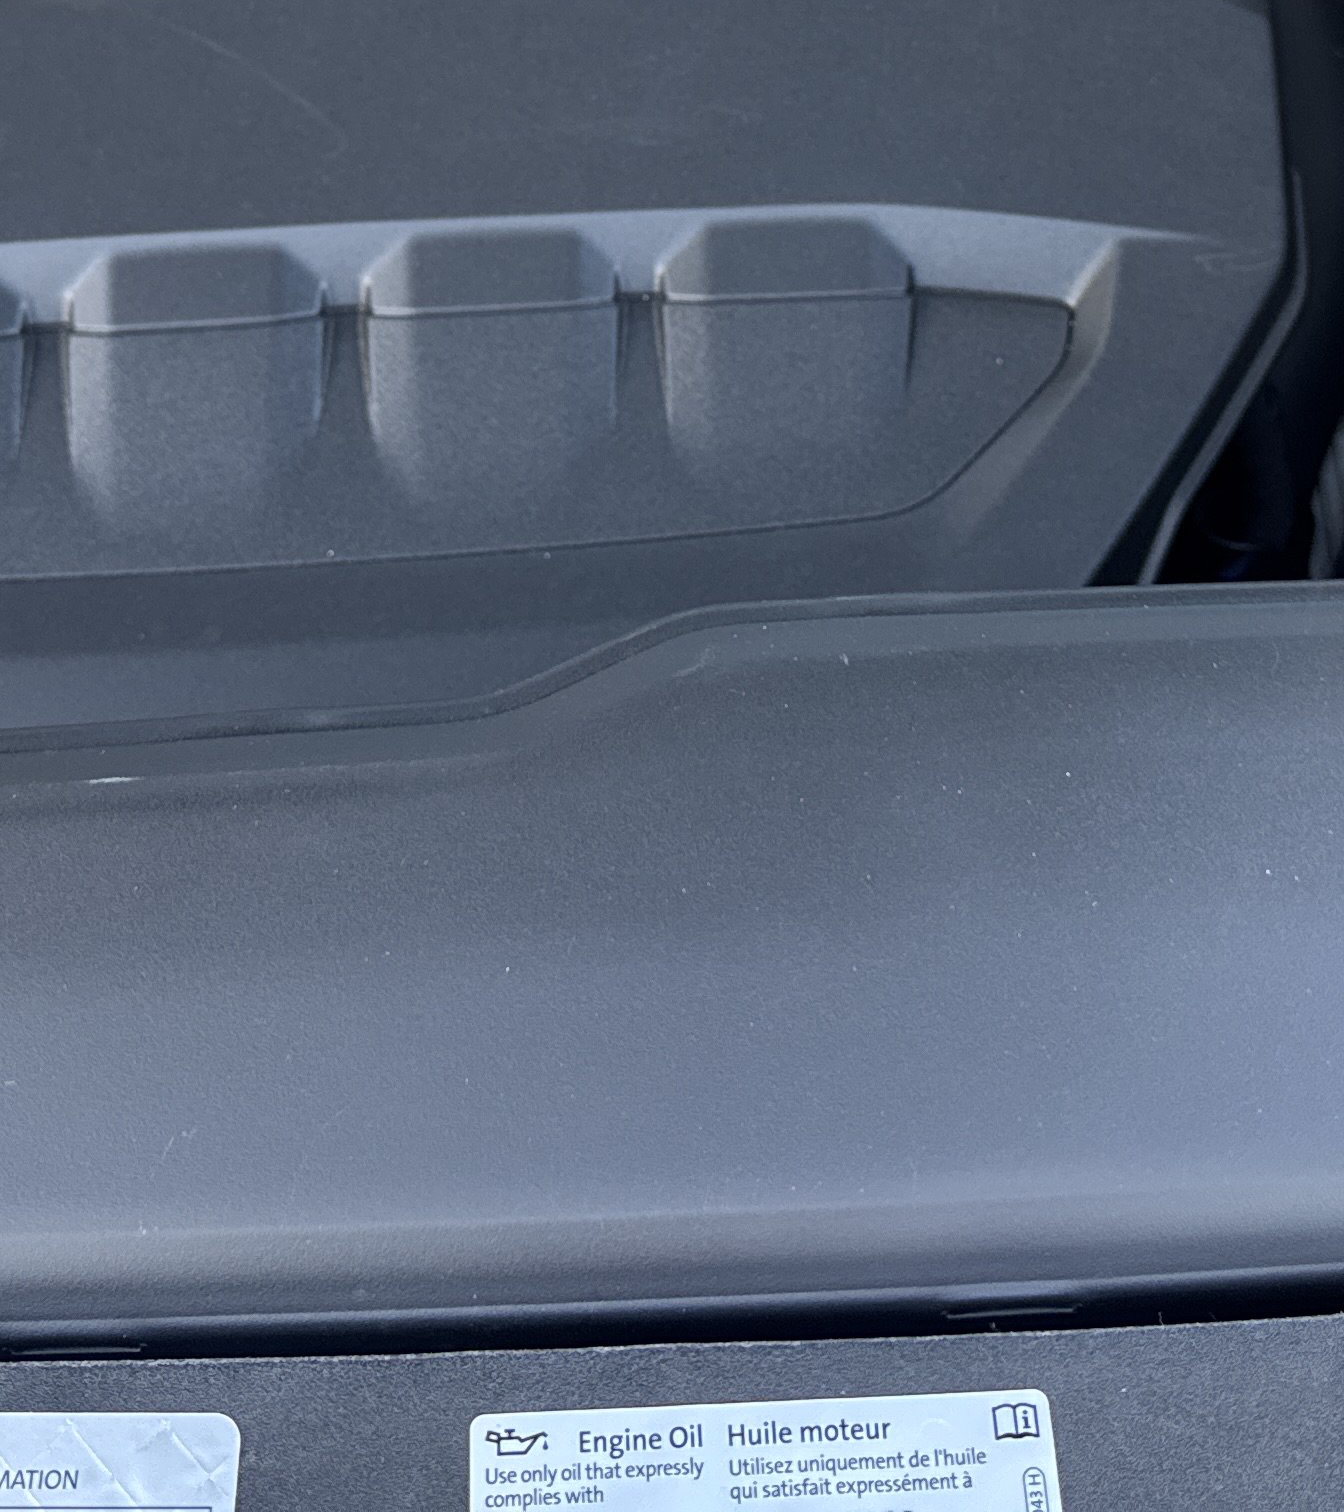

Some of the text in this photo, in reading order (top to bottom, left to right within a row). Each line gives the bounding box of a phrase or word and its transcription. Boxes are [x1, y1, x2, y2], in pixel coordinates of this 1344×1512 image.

[578, 1424, 704, 1459] Engine Oil
[727, 1419, 891, 1447] Huile moteur
[485, 1457, 705, 1487] Use only oil that expressly
[728, 1447, 988, 1478] Utilisez uniquement de l'huile
[730, 1470, 974, 1504] qui satisfait expressément à
[1027, 1473, 1042, 1486] H
[484, 1485, 605, 1510] complies with
